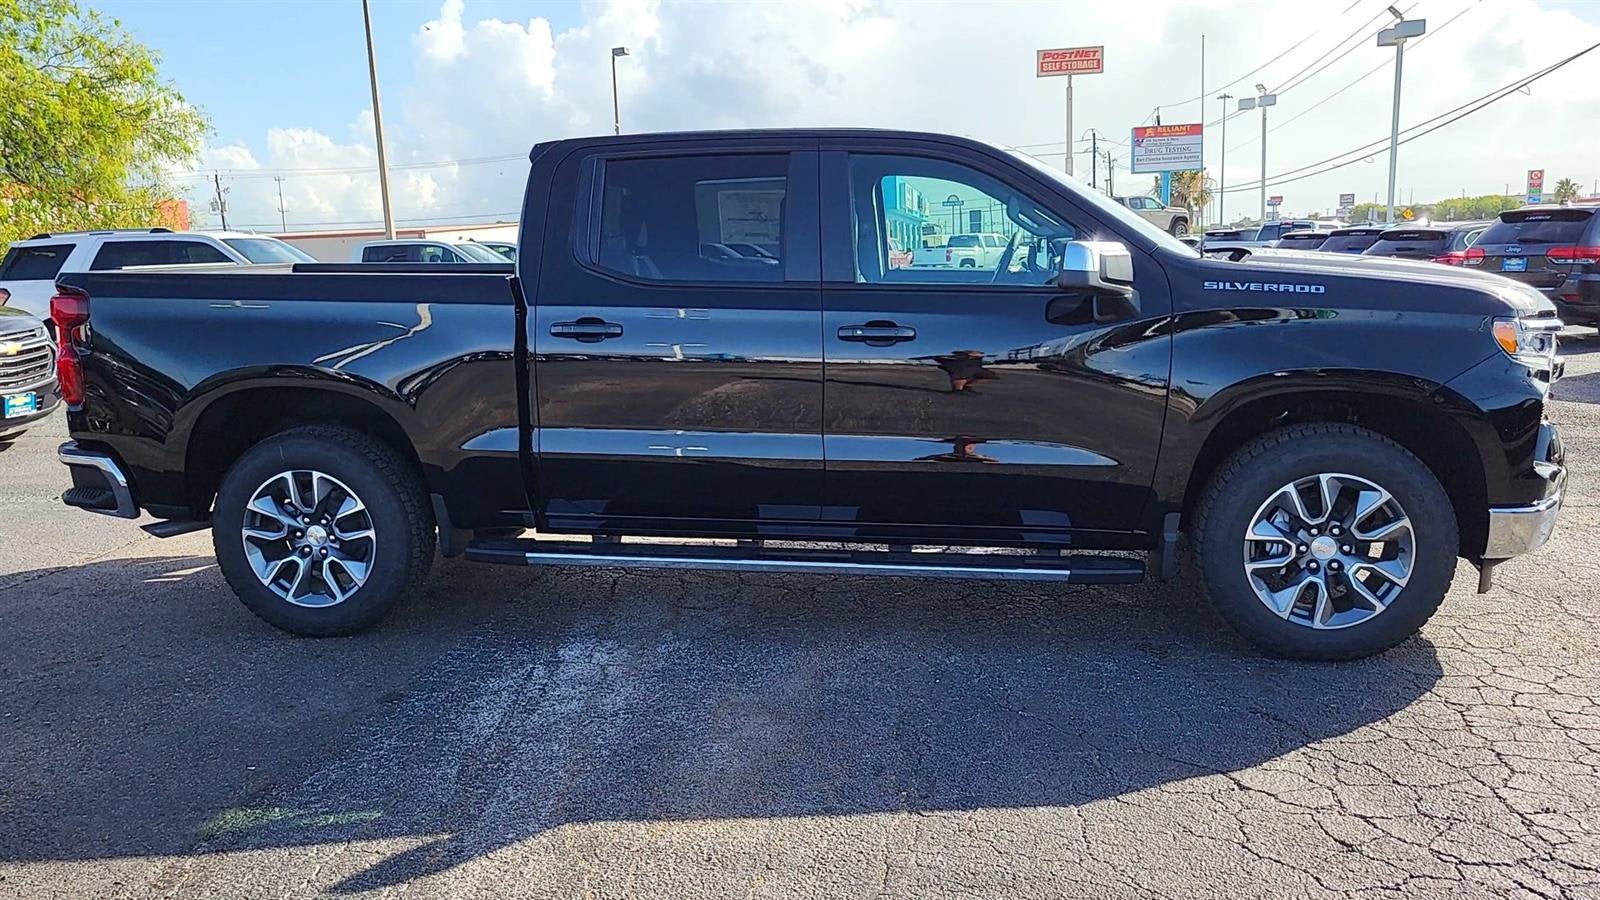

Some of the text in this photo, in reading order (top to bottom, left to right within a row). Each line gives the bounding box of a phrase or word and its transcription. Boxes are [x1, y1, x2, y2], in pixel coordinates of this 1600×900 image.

[1042, 60, 1100, 71] SELF STORAGE
[1157, 125, 1191, 133] RELIANT
[1203, 281, 1325, 293] SILVERADO
